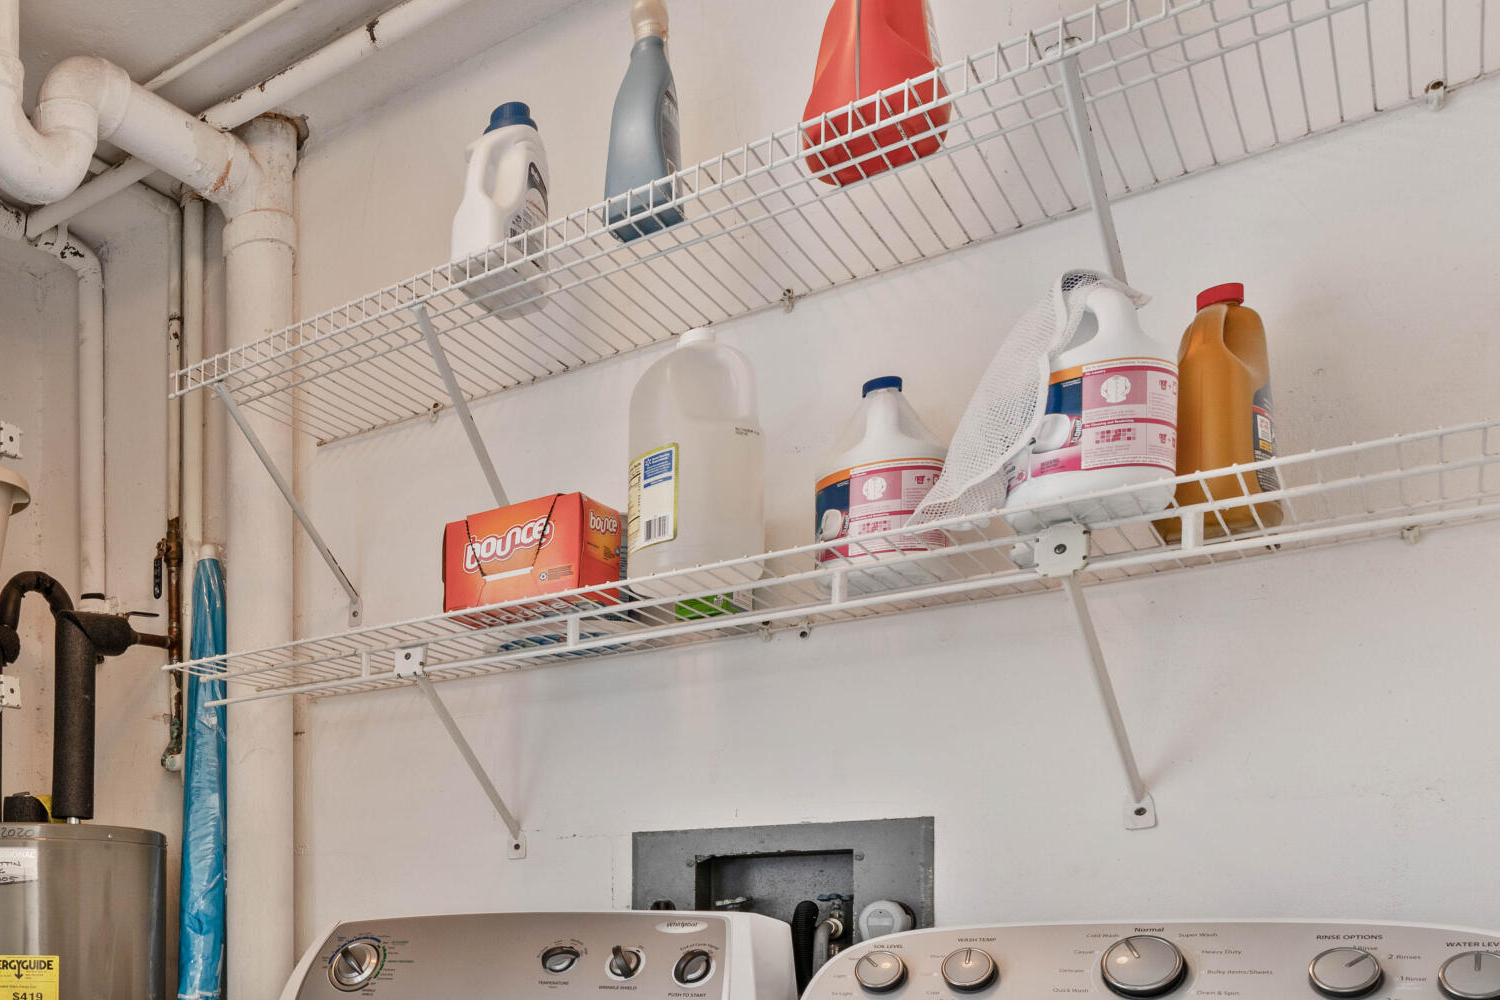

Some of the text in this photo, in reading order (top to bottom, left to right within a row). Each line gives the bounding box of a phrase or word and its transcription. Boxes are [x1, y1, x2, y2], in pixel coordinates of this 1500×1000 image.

[589, 511, 618, 534] bounce
[464, 516, 551, 573] bounce
[1, 827, 36, 838] 2020
